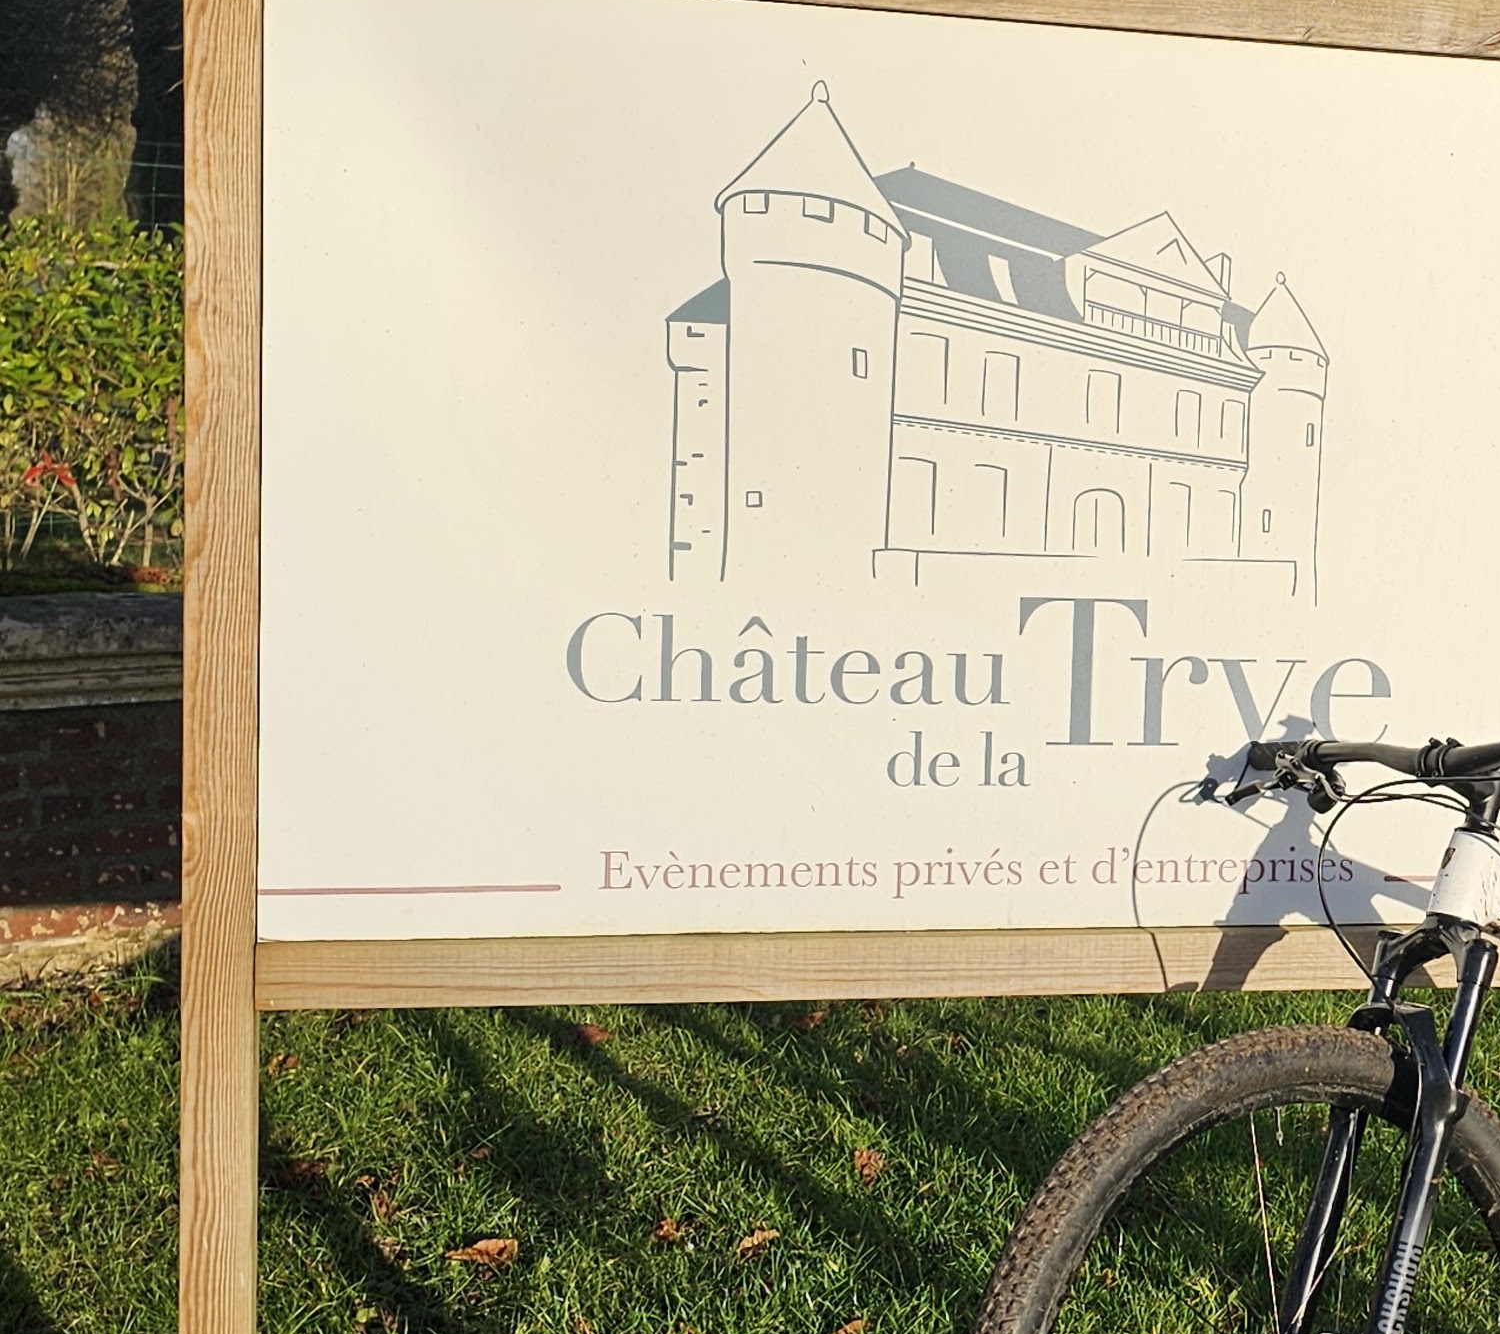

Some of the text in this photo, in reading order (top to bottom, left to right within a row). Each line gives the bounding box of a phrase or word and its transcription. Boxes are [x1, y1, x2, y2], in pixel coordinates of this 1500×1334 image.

[567, 597, 1392, 803] Château Trye
[887, 731, 1031, 788] de la
[600, 845, 1354, 900] Evènements privés et d'entreprises
